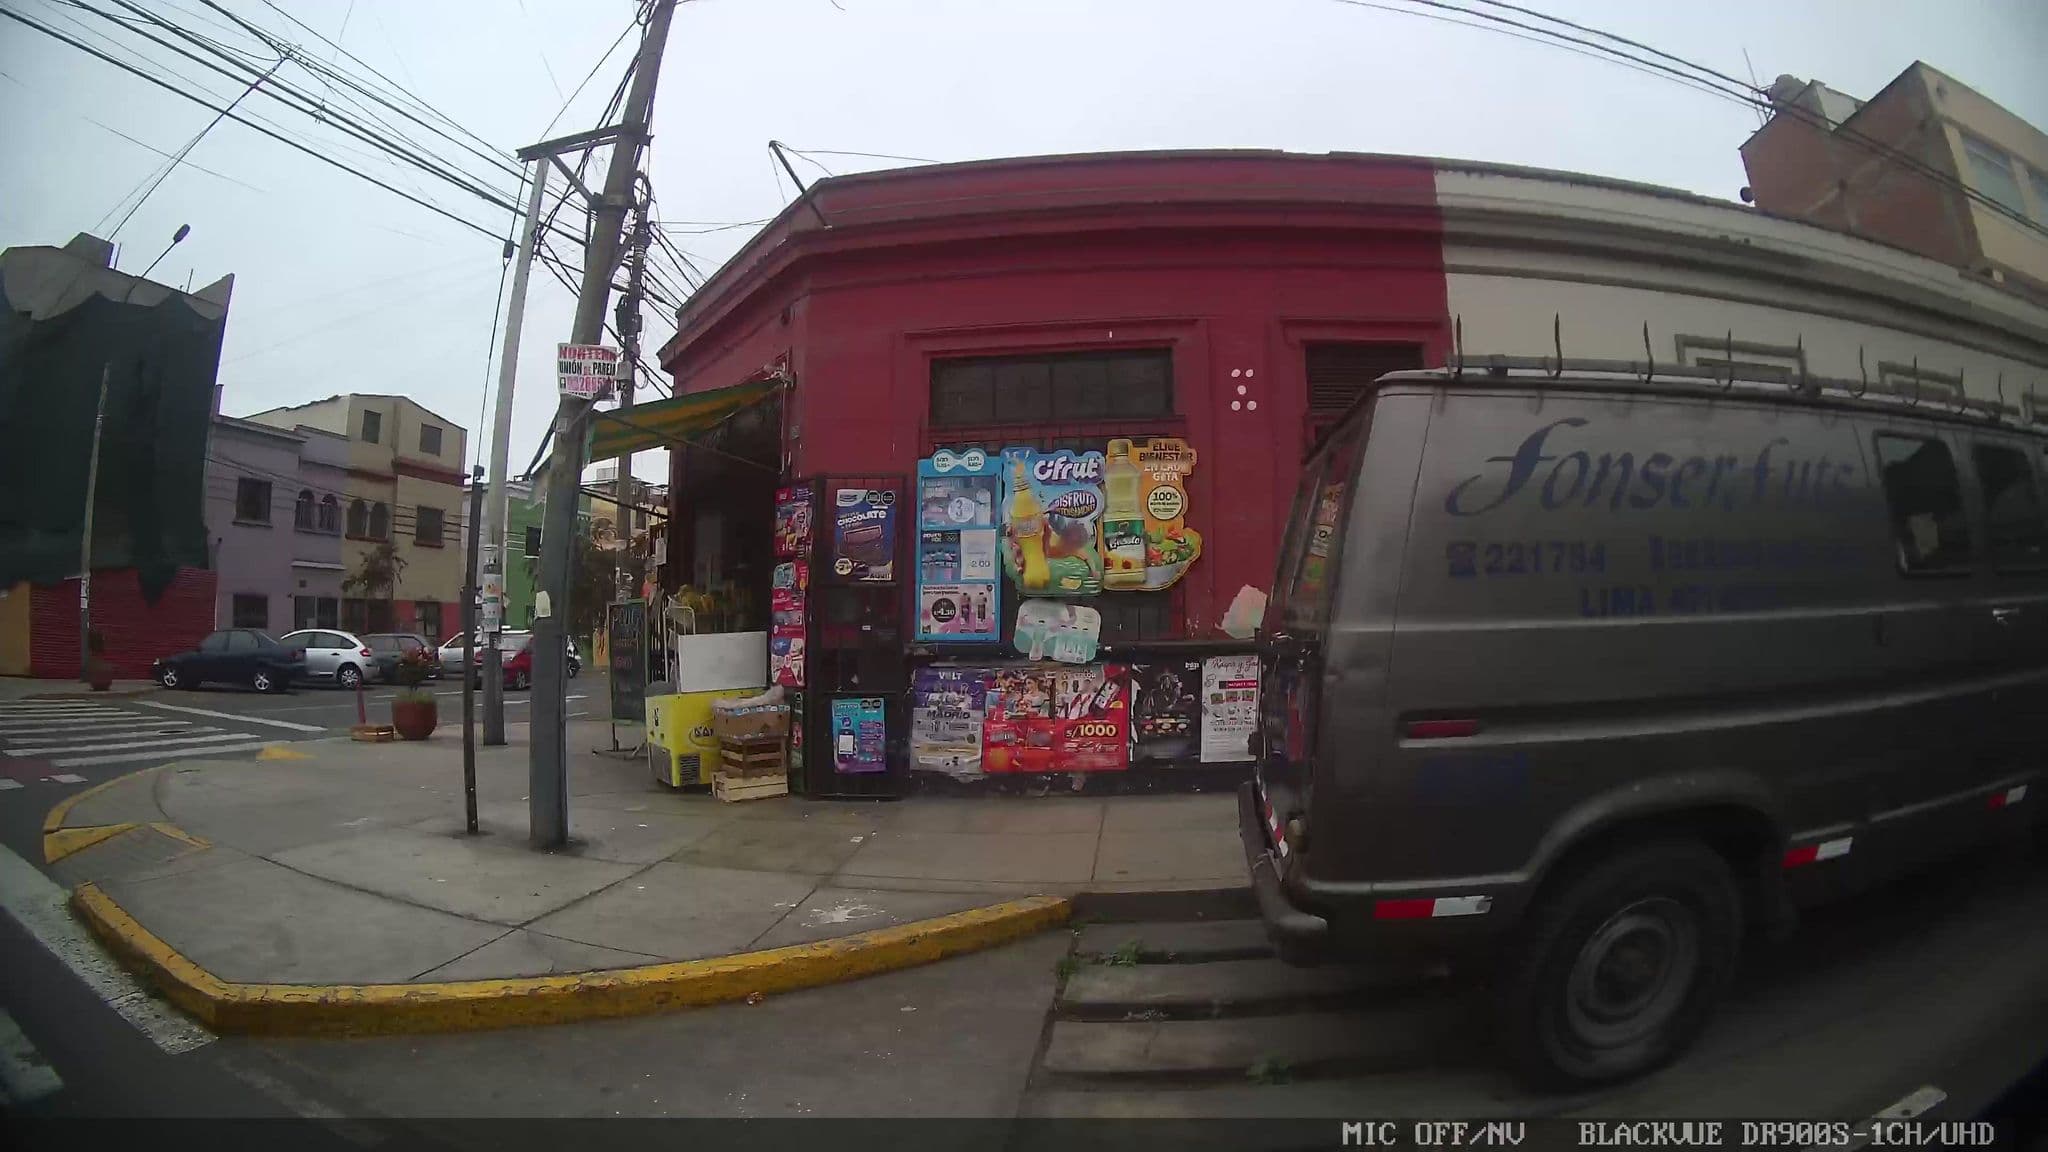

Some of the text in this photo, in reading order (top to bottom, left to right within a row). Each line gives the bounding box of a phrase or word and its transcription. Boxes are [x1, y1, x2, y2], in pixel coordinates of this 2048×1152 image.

[559, 360, 582, 374] UNIÓN
[1055, 492, 1095, 508] DISFRUTA
[837, 510, 887, 526] CHOCOLATE
